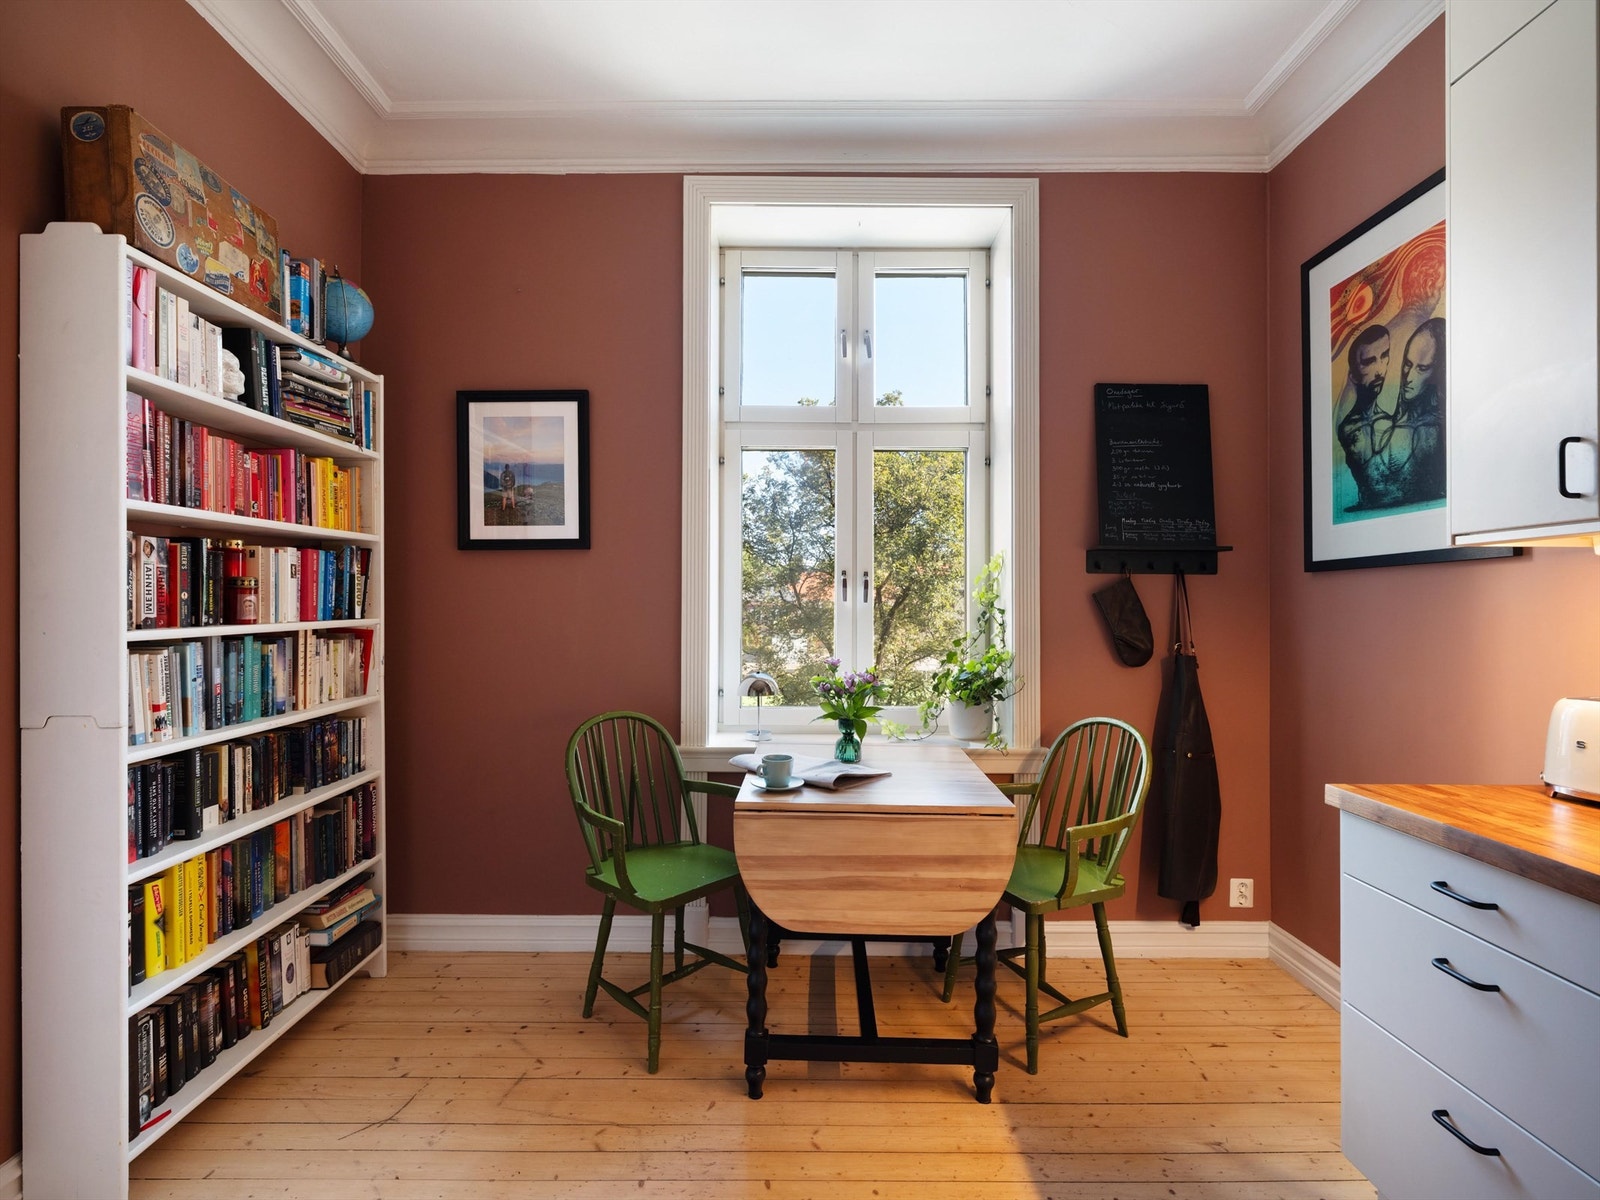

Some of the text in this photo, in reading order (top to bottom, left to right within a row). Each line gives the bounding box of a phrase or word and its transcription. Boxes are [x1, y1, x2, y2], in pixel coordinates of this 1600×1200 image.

[181, 546, 189, 571] HITLER'S
[259, 961, 268, 1011] HARRY POTTER
[142, 1022, 151, 1060] CATHEDRAL
[142, 1073, 150, 1087] SEA
